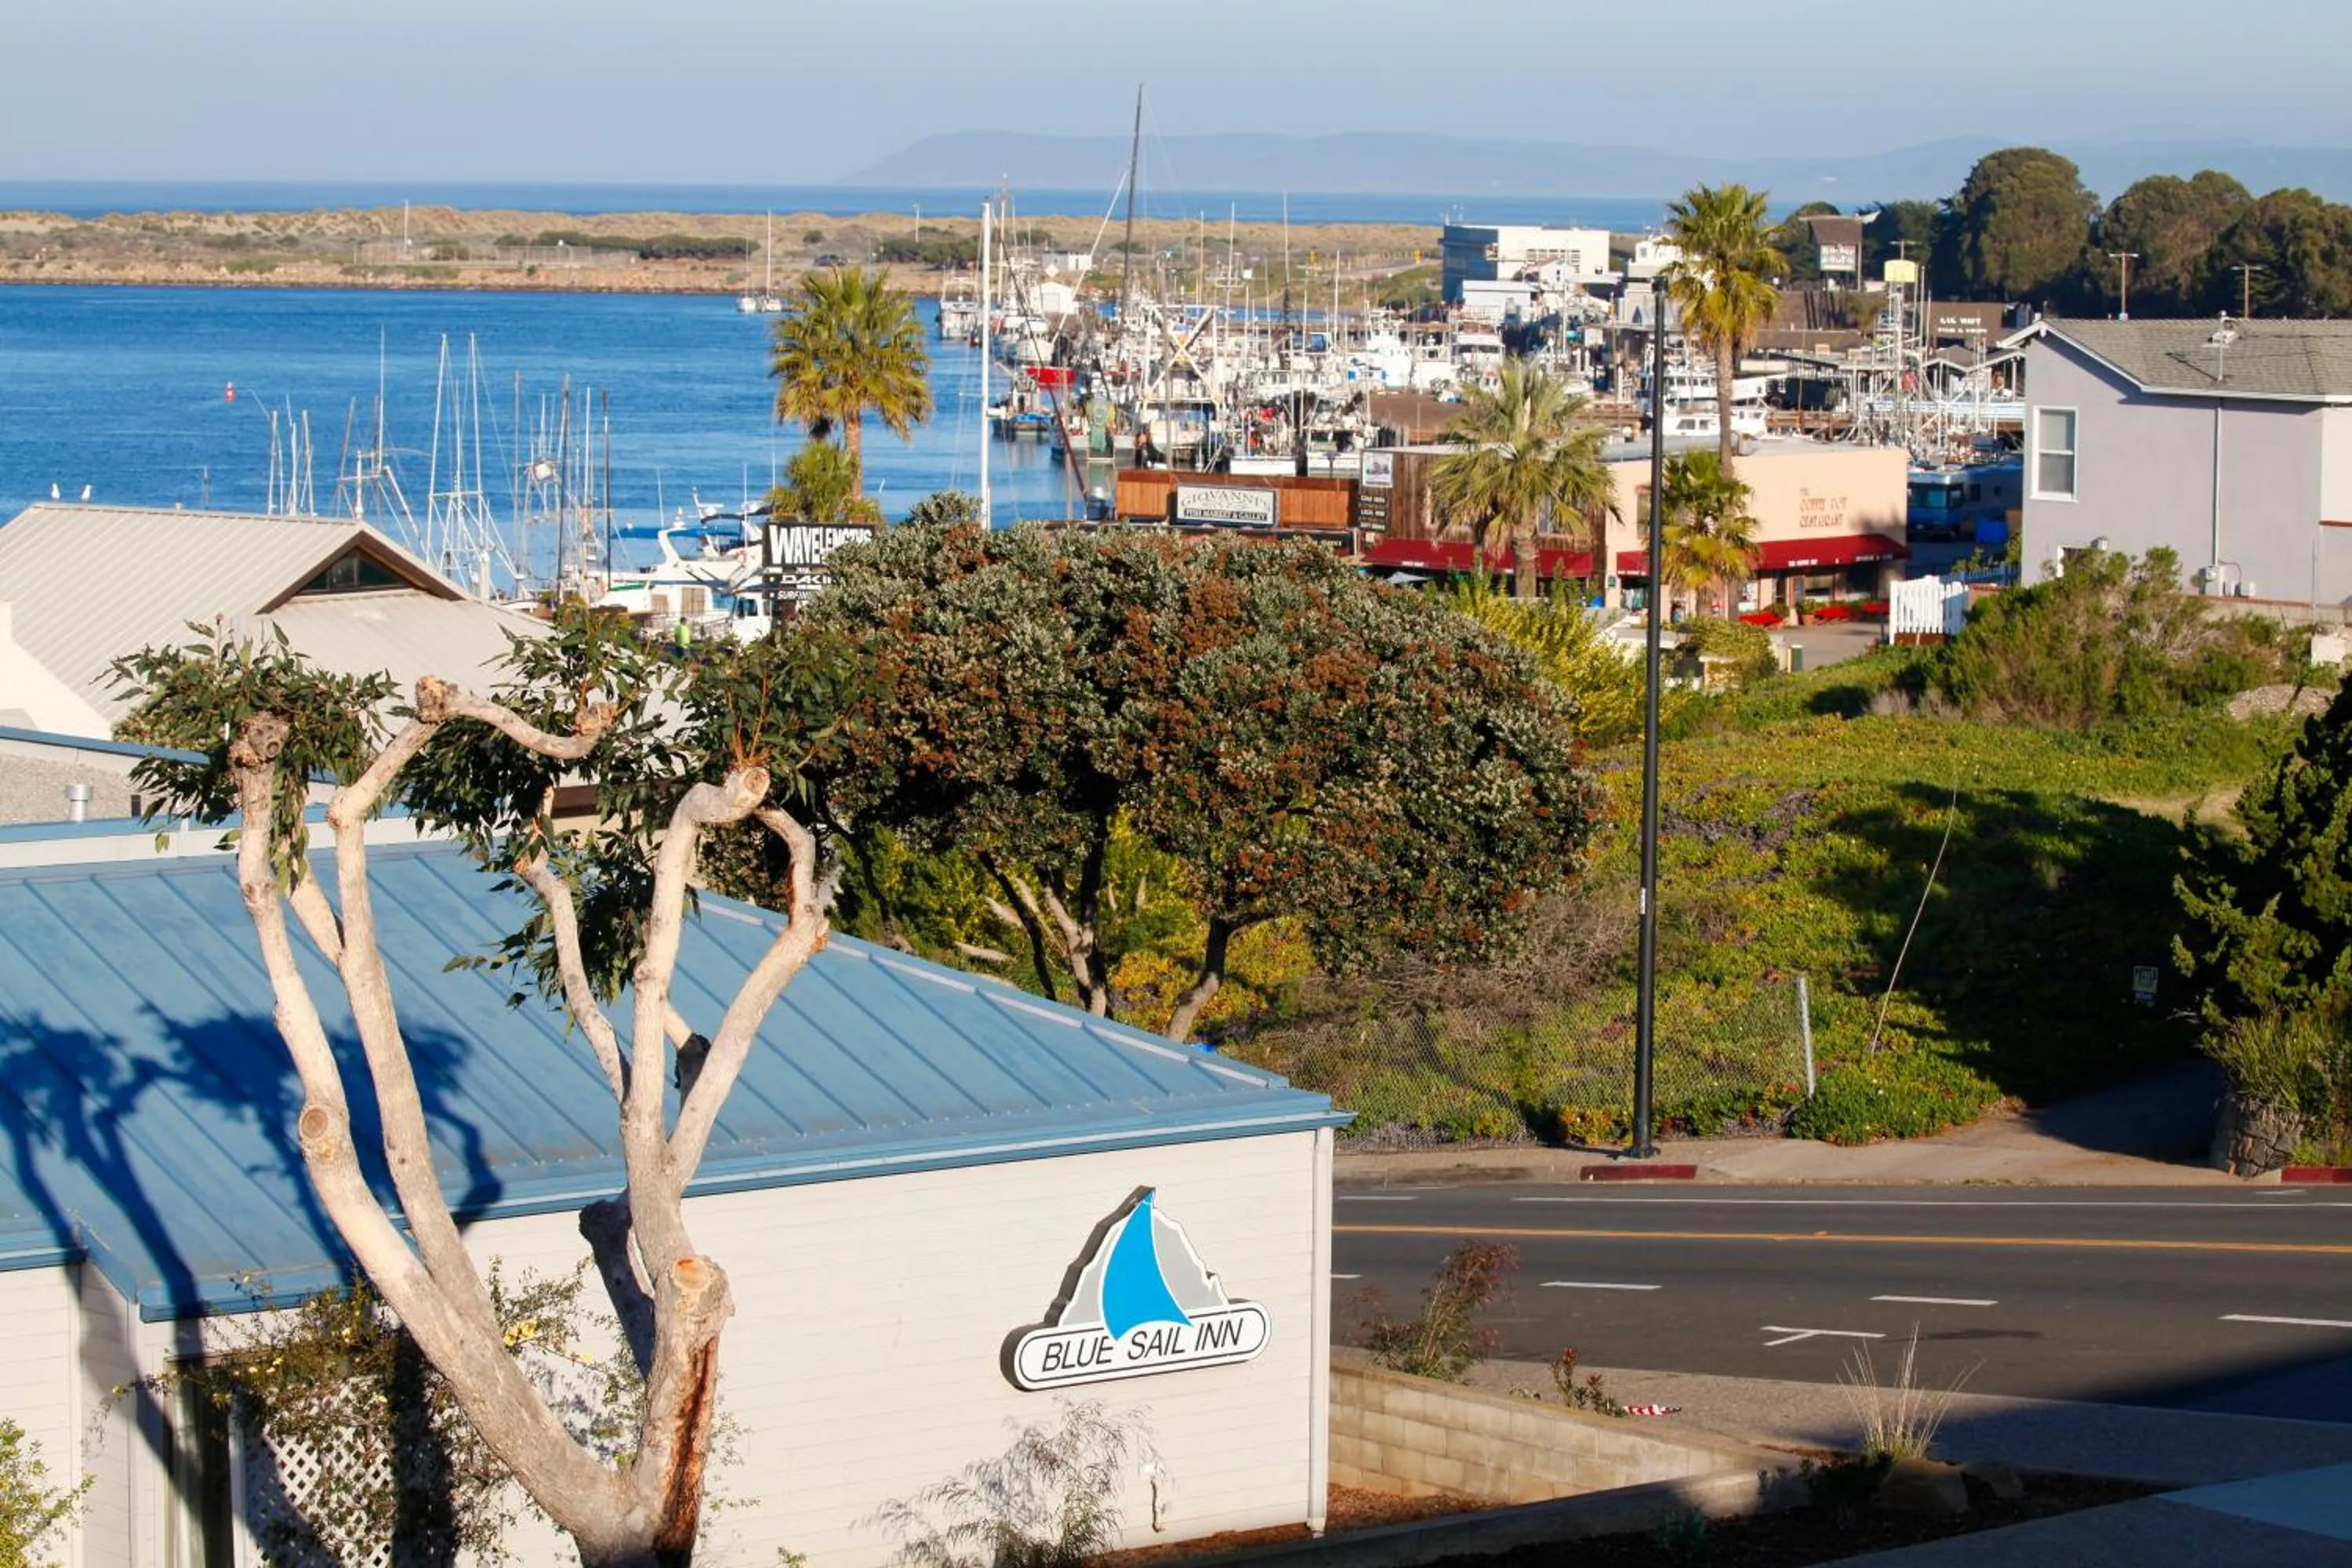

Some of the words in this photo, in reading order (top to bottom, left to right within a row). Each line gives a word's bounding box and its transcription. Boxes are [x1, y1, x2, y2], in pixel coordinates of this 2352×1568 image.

[1041, 1335, 1114, 1372] BLUE
[1127, 1326, 1185, 1360] SAIL
[1194, 1318, 1244, 1352] INN
